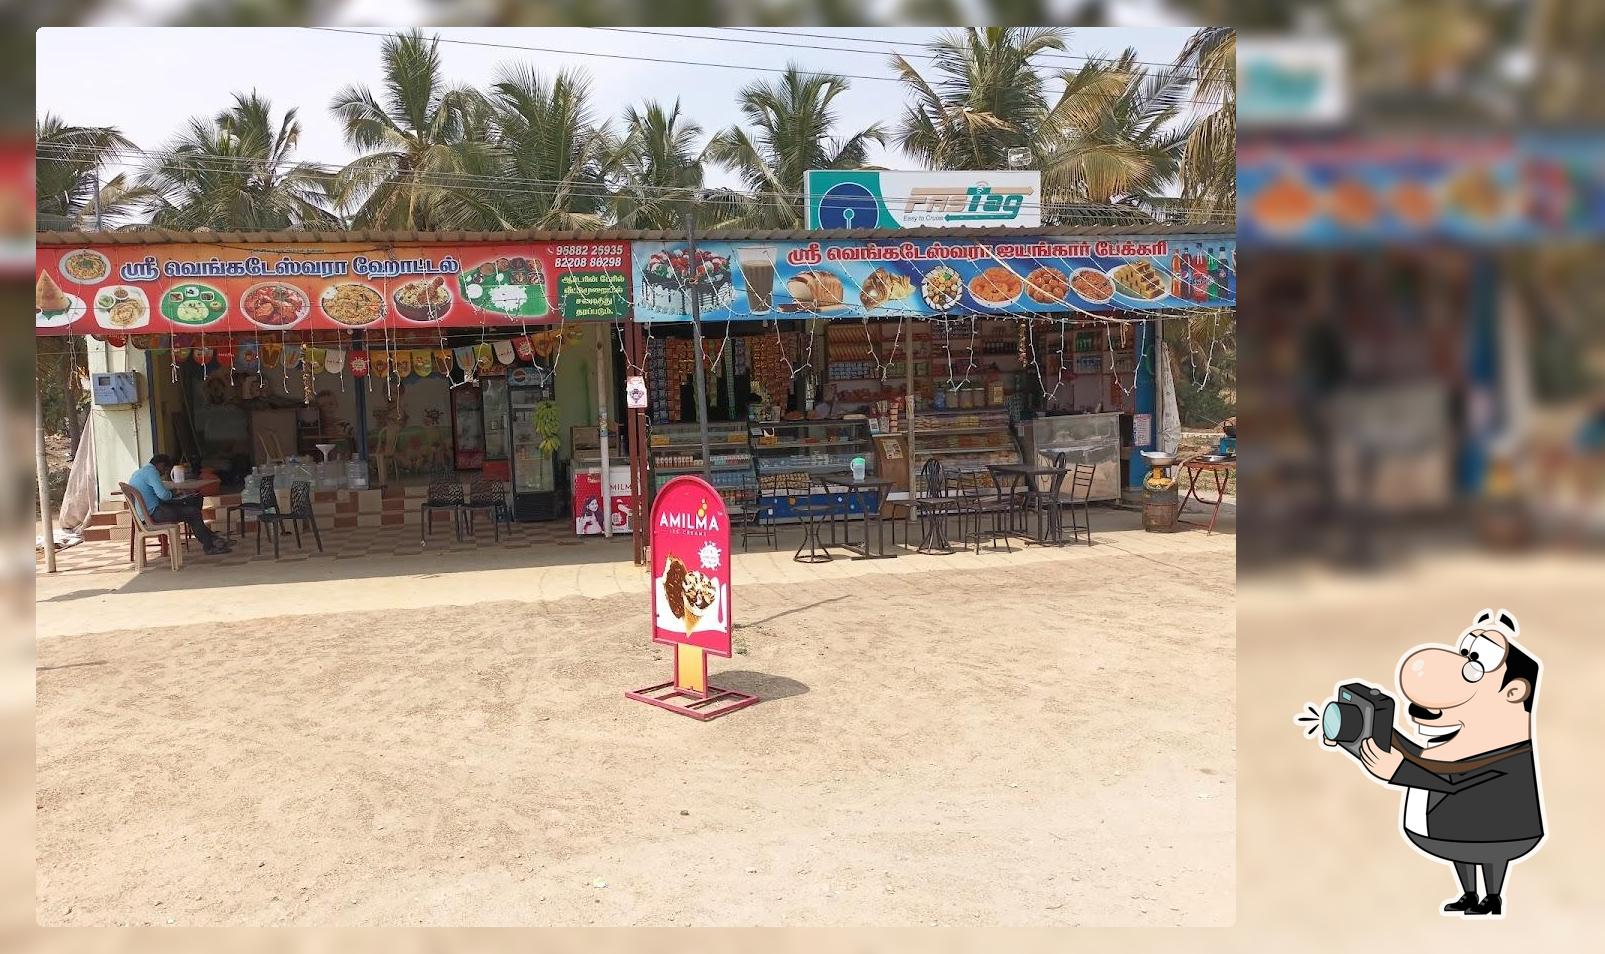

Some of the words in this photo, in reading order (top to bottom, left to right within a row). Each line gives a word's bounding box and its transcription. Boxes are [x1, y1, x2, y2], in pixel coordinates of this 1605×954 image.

[787, 242, 822, 266] ஸ்ரீ
[826, 241, 992, 263] வெங்கடேஸ்வரா
[995, 241, 1091, 258] ஐயங்கார்
[1094, 240, 1168, 258] பேக்கரி
[120, 255, 160, 281] ஸ்ரீ
[163, 256, 348, 278] வெங்கடேஸ்வரா
[352, 255, 460, 280] ஹோட்டல்
[659, 512, 719, 531] AMILMA
